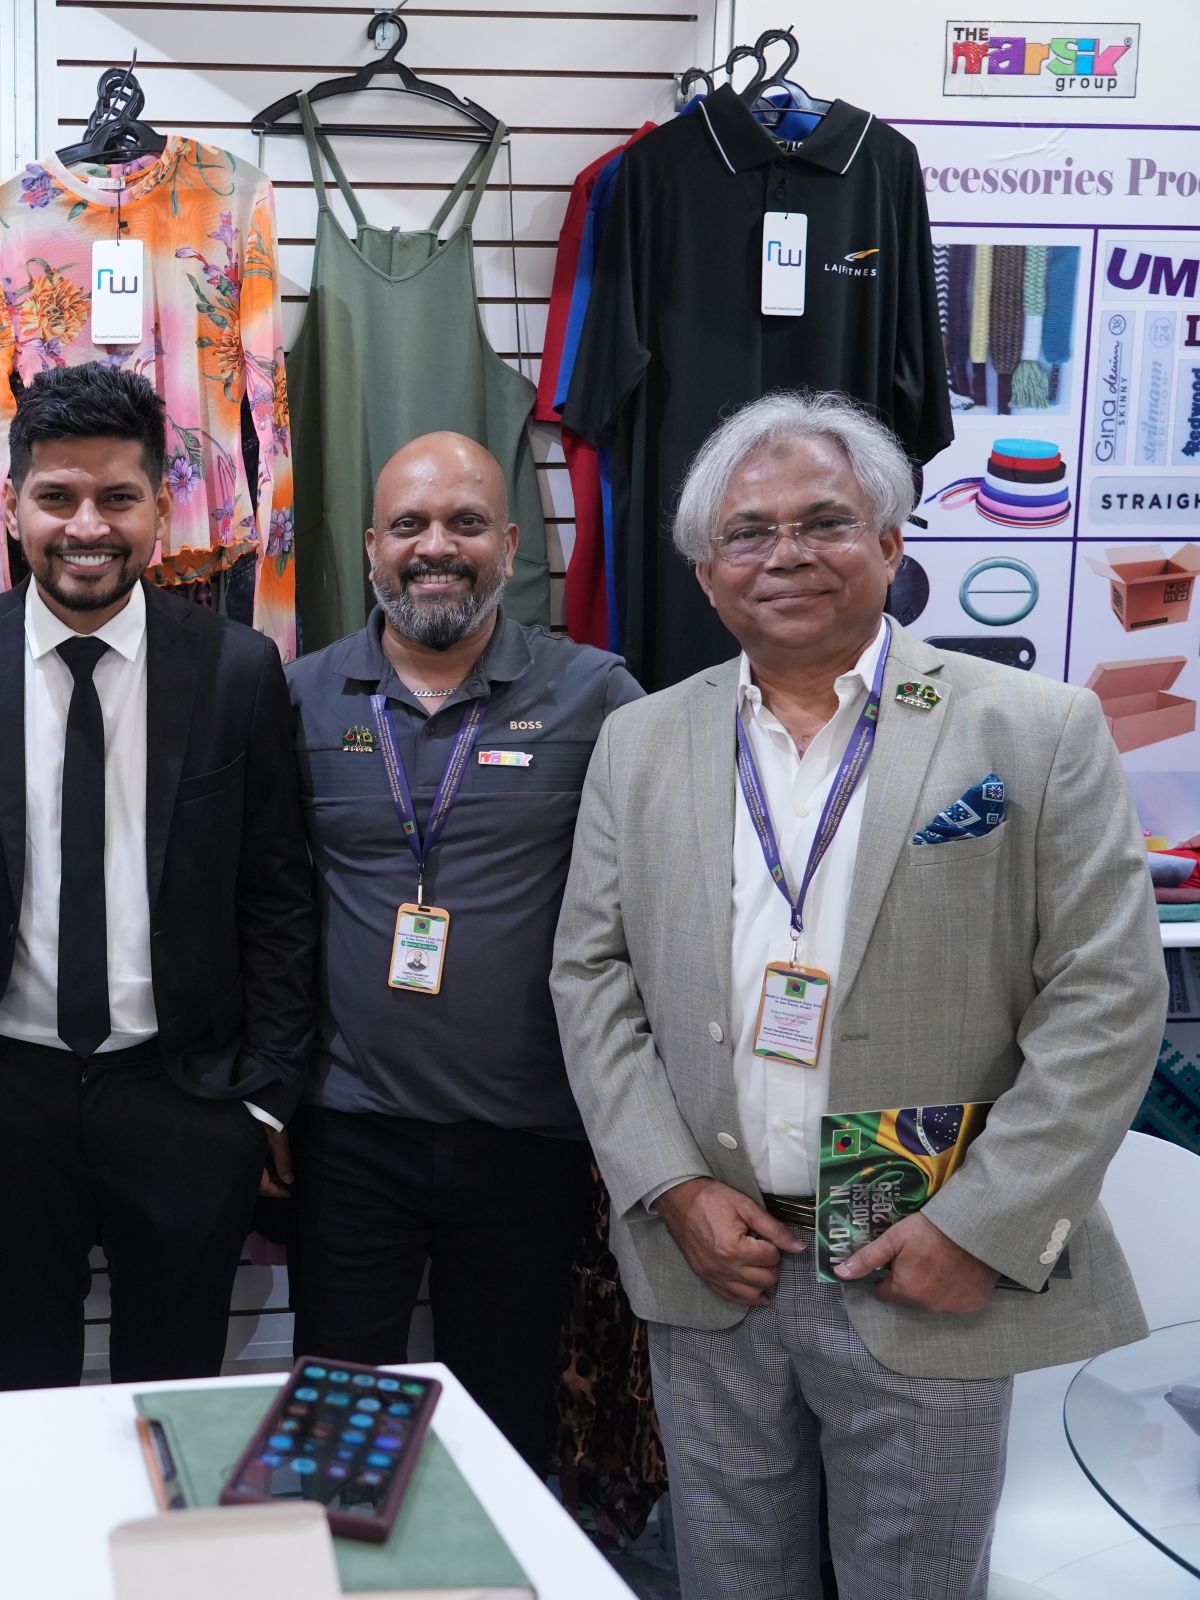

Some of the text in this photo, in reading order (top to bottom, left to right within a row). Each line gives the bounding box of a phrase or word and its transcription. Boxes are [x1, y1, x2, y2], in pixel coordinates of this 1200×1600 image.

[953, 27, 989, 41] THE
[1055, 77, 1118, 92] group
[922, 157, 1200, 197] ccessories Pro
[1159, 325, 1170, 342] 24
[1118, 377, 1128, 426] SKINNY
[509, 720, 543, 730] BOSS
[829, 1184, 851, 1205] IN
